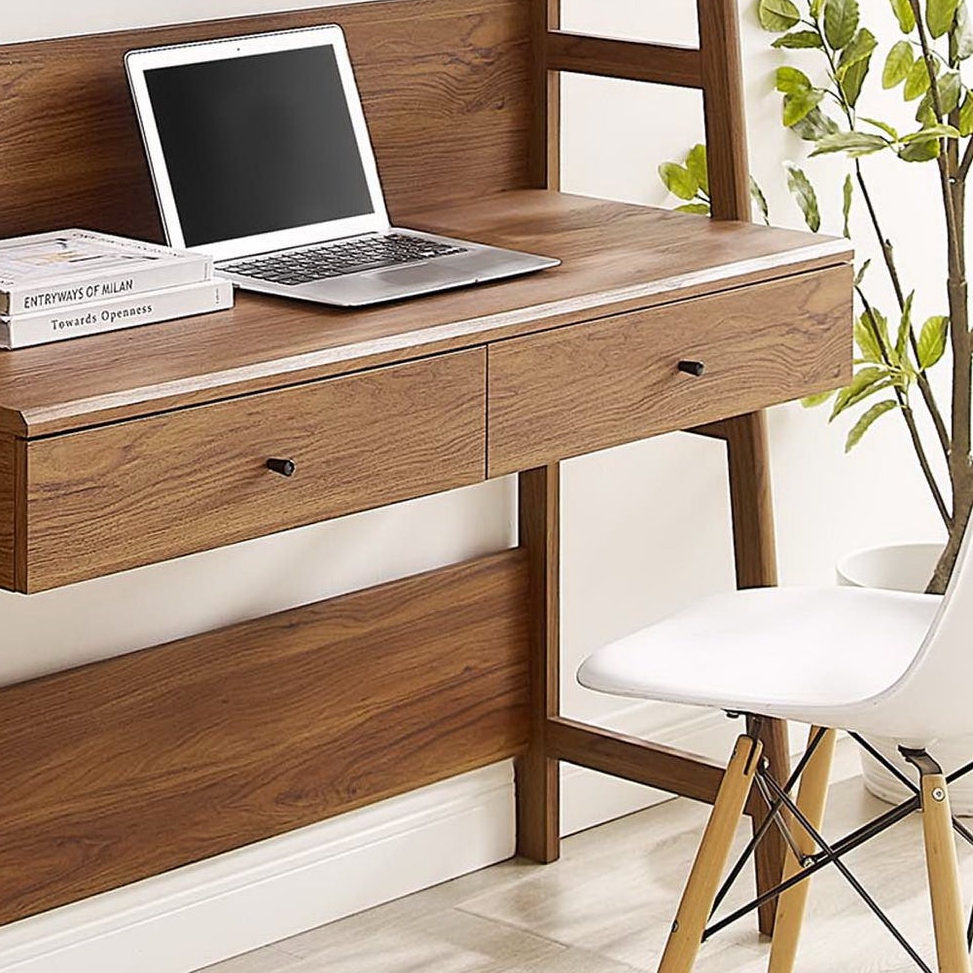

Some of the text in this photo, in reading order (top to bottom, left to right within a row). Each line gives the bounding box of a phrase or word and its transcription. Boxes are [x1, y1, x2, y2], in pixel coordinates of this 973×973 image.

[23, 279, 133, 309] ENTRYWAYS OF MILAN
[50, 304, 153, 330] Towards Openness
